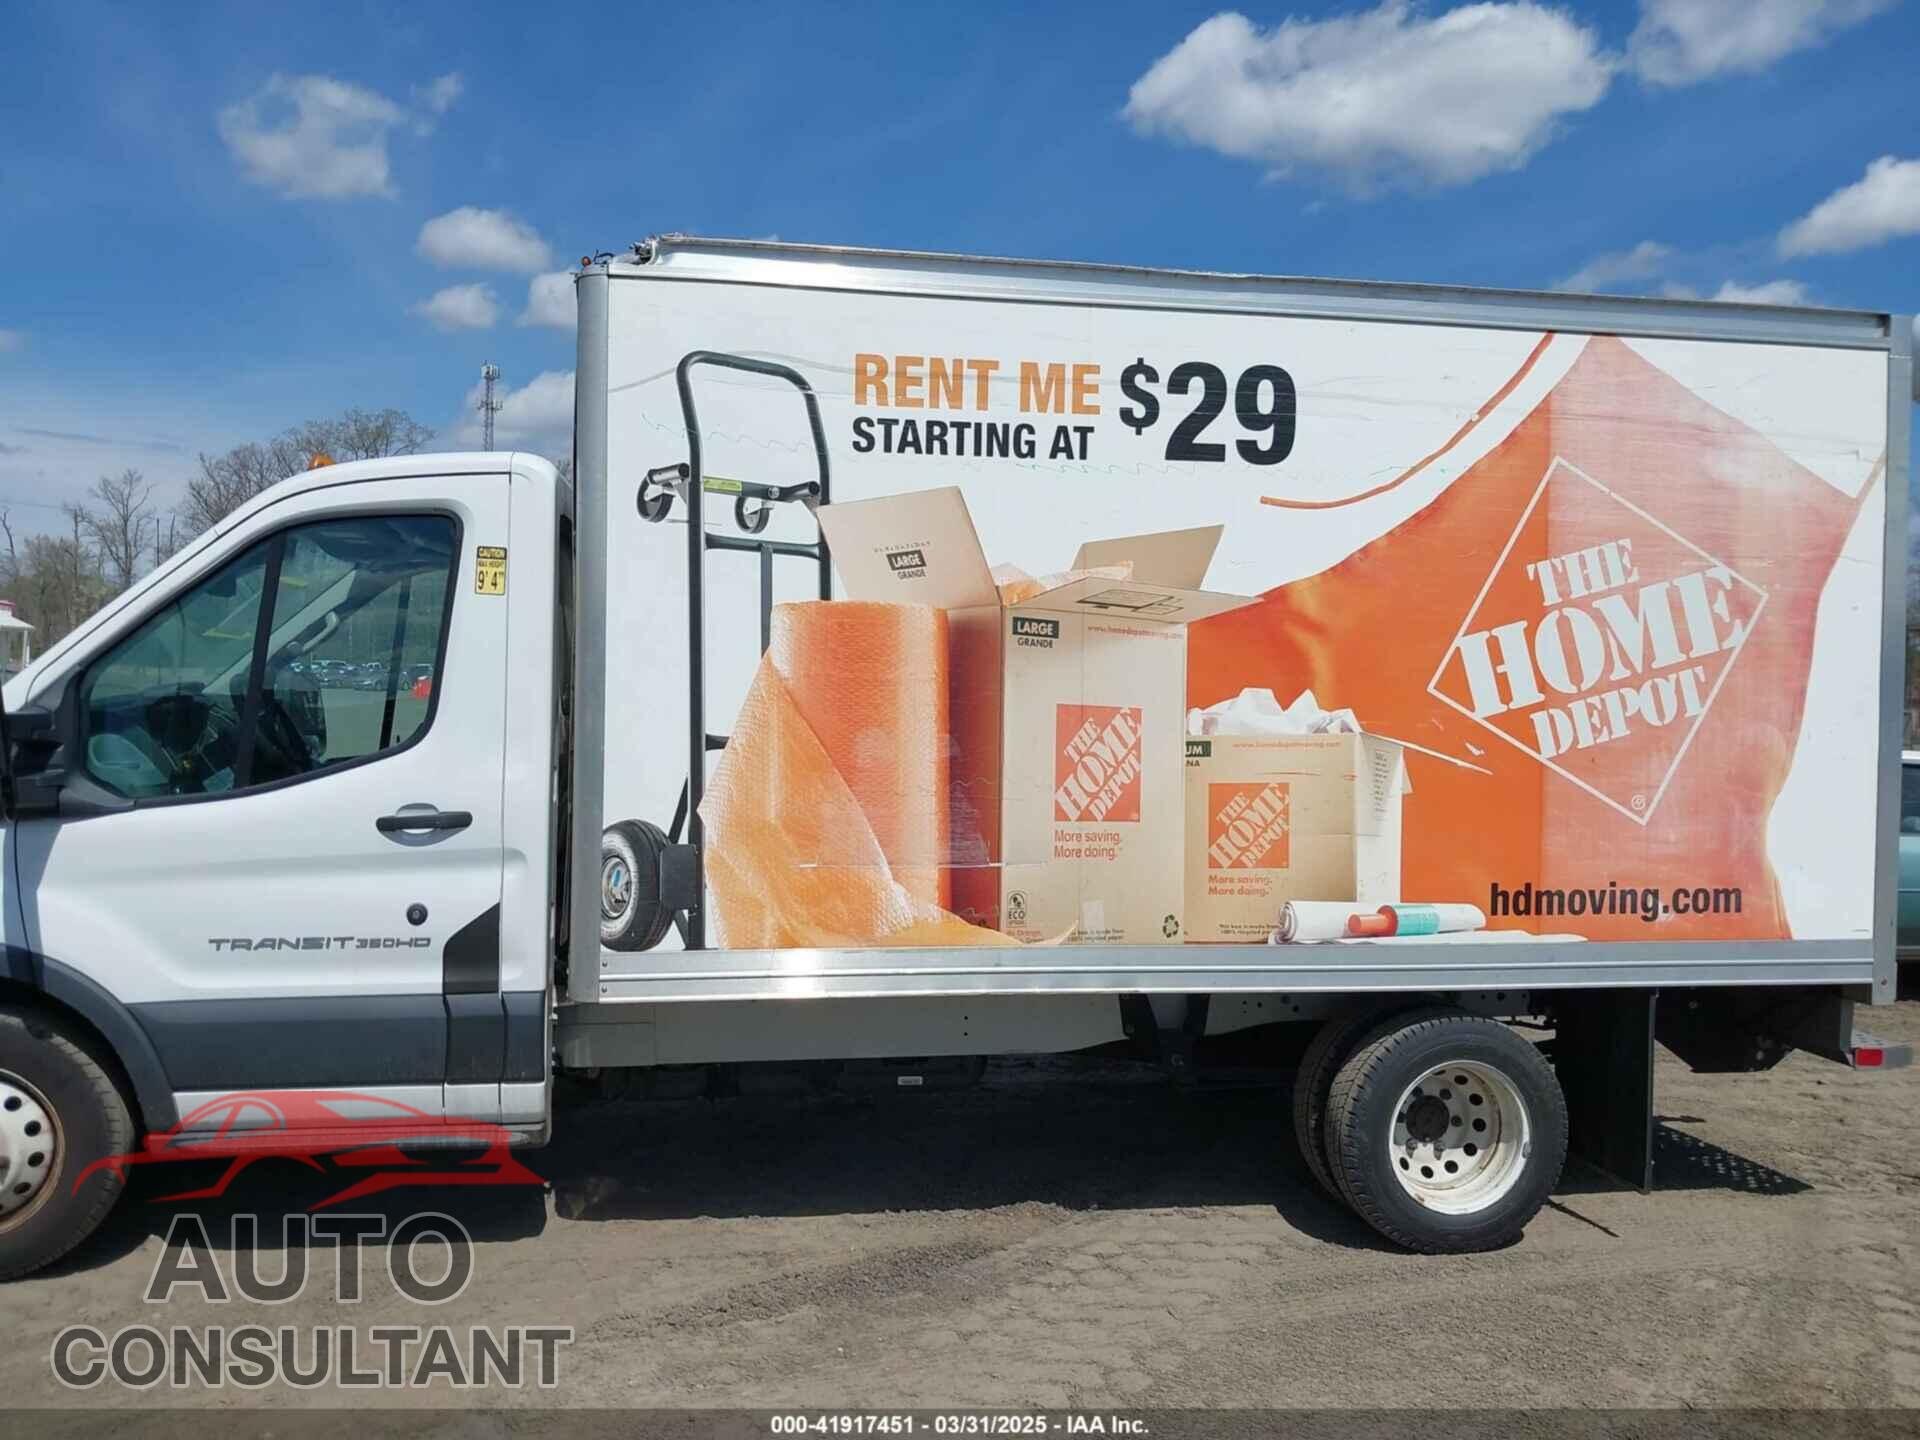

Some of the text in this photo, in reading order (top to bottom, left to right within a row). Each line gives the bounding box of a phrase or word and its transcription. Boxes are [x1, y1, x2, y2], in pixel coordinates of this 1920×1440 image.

[854, 353, 1101, 416] RENT ME
[1119, 357, 1297, 466] $29
[852, 416, 1095, 461] STARTING AT
[892, 553, 922, 568] LARGE
[1526, 538, 1639, 607] THE
[1016, 620, 1055, 636] LARGE
[1016, 637, 1054, 649] GRANDE
[1456, 565, 1746, 719] HOME
[1529, 665, 1705, 760] DEPOT
[1063, 716, 1100, 763] THE
[1054, 707, 1142, 822] HOME
[1088, 749, 1141, 822] DEPOT
[1207, 783, 1290, 868] HOME
[1216, 792, 1250, 827] THE
[1053, 845, 1119, 861] More doing.
[1054, 830, 1082, 842] More
[1240, 814, 1290, 868] DEPOT
[1207, 875, 1235, 884] More
[1207, 886, 1235, 896] More
[1490, 881, 1743, 922] hdmoving.com
[1008, 911, 1026, 920] ECO
